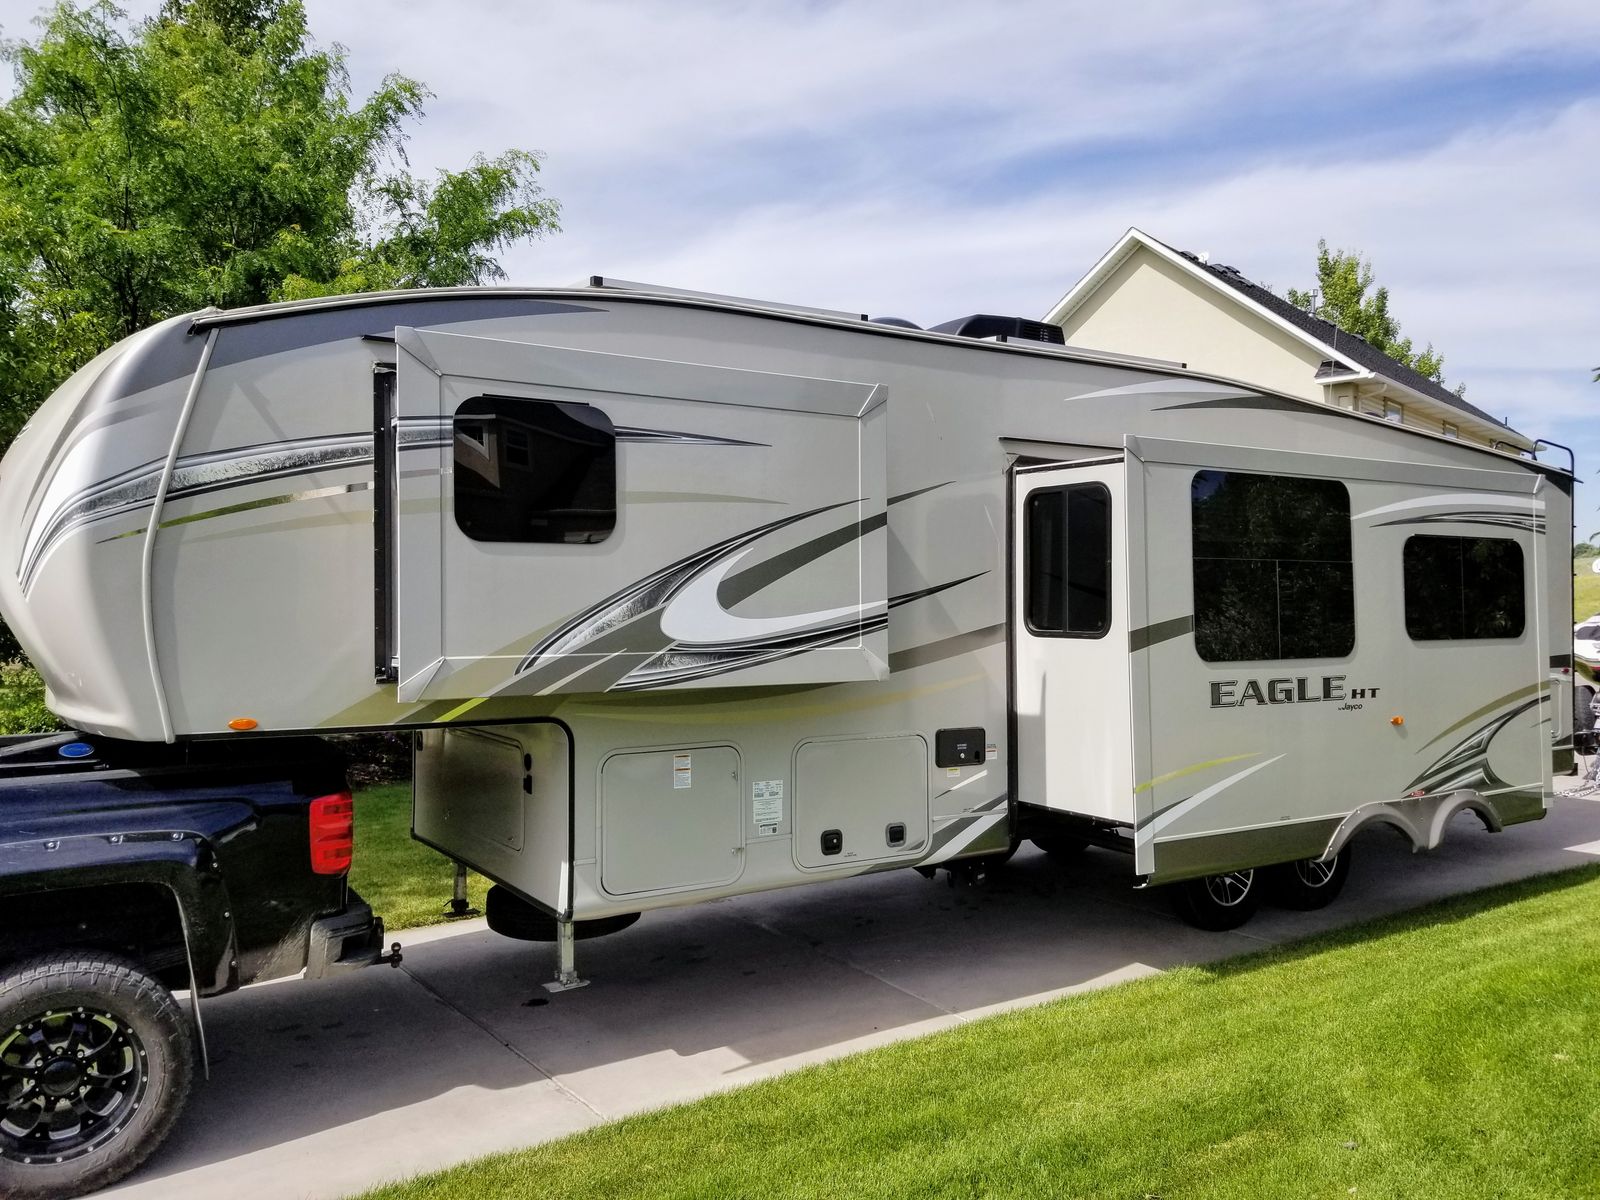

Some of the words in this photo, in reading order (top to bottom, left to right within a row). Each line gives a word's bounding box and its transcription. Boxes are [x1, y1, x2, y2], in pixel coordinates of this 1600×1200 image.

[1209, 675, 1347, 708] EAGLE
[1351, 688, 1380, 699] HT
[1342, 702, 1363, 711] Jayco
